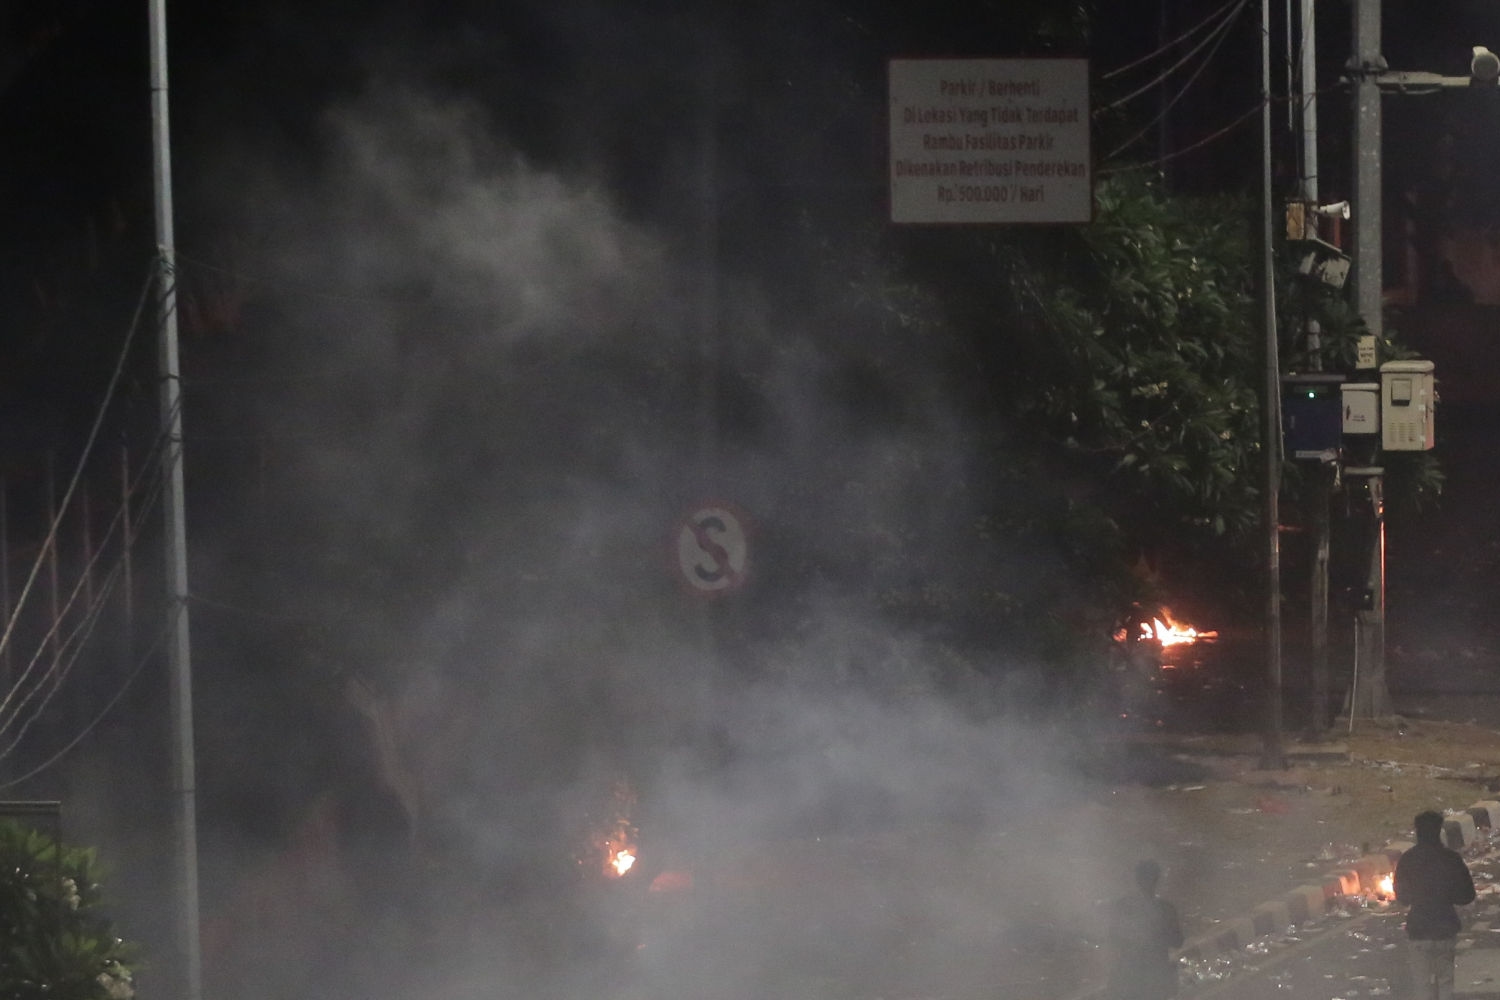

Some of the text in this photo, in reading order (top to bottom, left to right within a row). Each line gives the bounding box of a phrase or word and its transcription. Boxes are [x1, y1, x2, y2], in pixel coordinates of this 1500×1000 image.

[940, 79, 976, 96] Parkir
[988, 79, 1040, 96] Berhenti
[903, 106, 1079, 127] Di Lokasi Yang Tidak Terdapat
[923, 134, 1054, 150] Rambu Fasilitas Parkir
[895, 160, 1086, 177] Dikenakan Retribusi Penderekan
[959, 185, 1008, 201] 500.000
[1020, 185, 1044, 201] Hari
